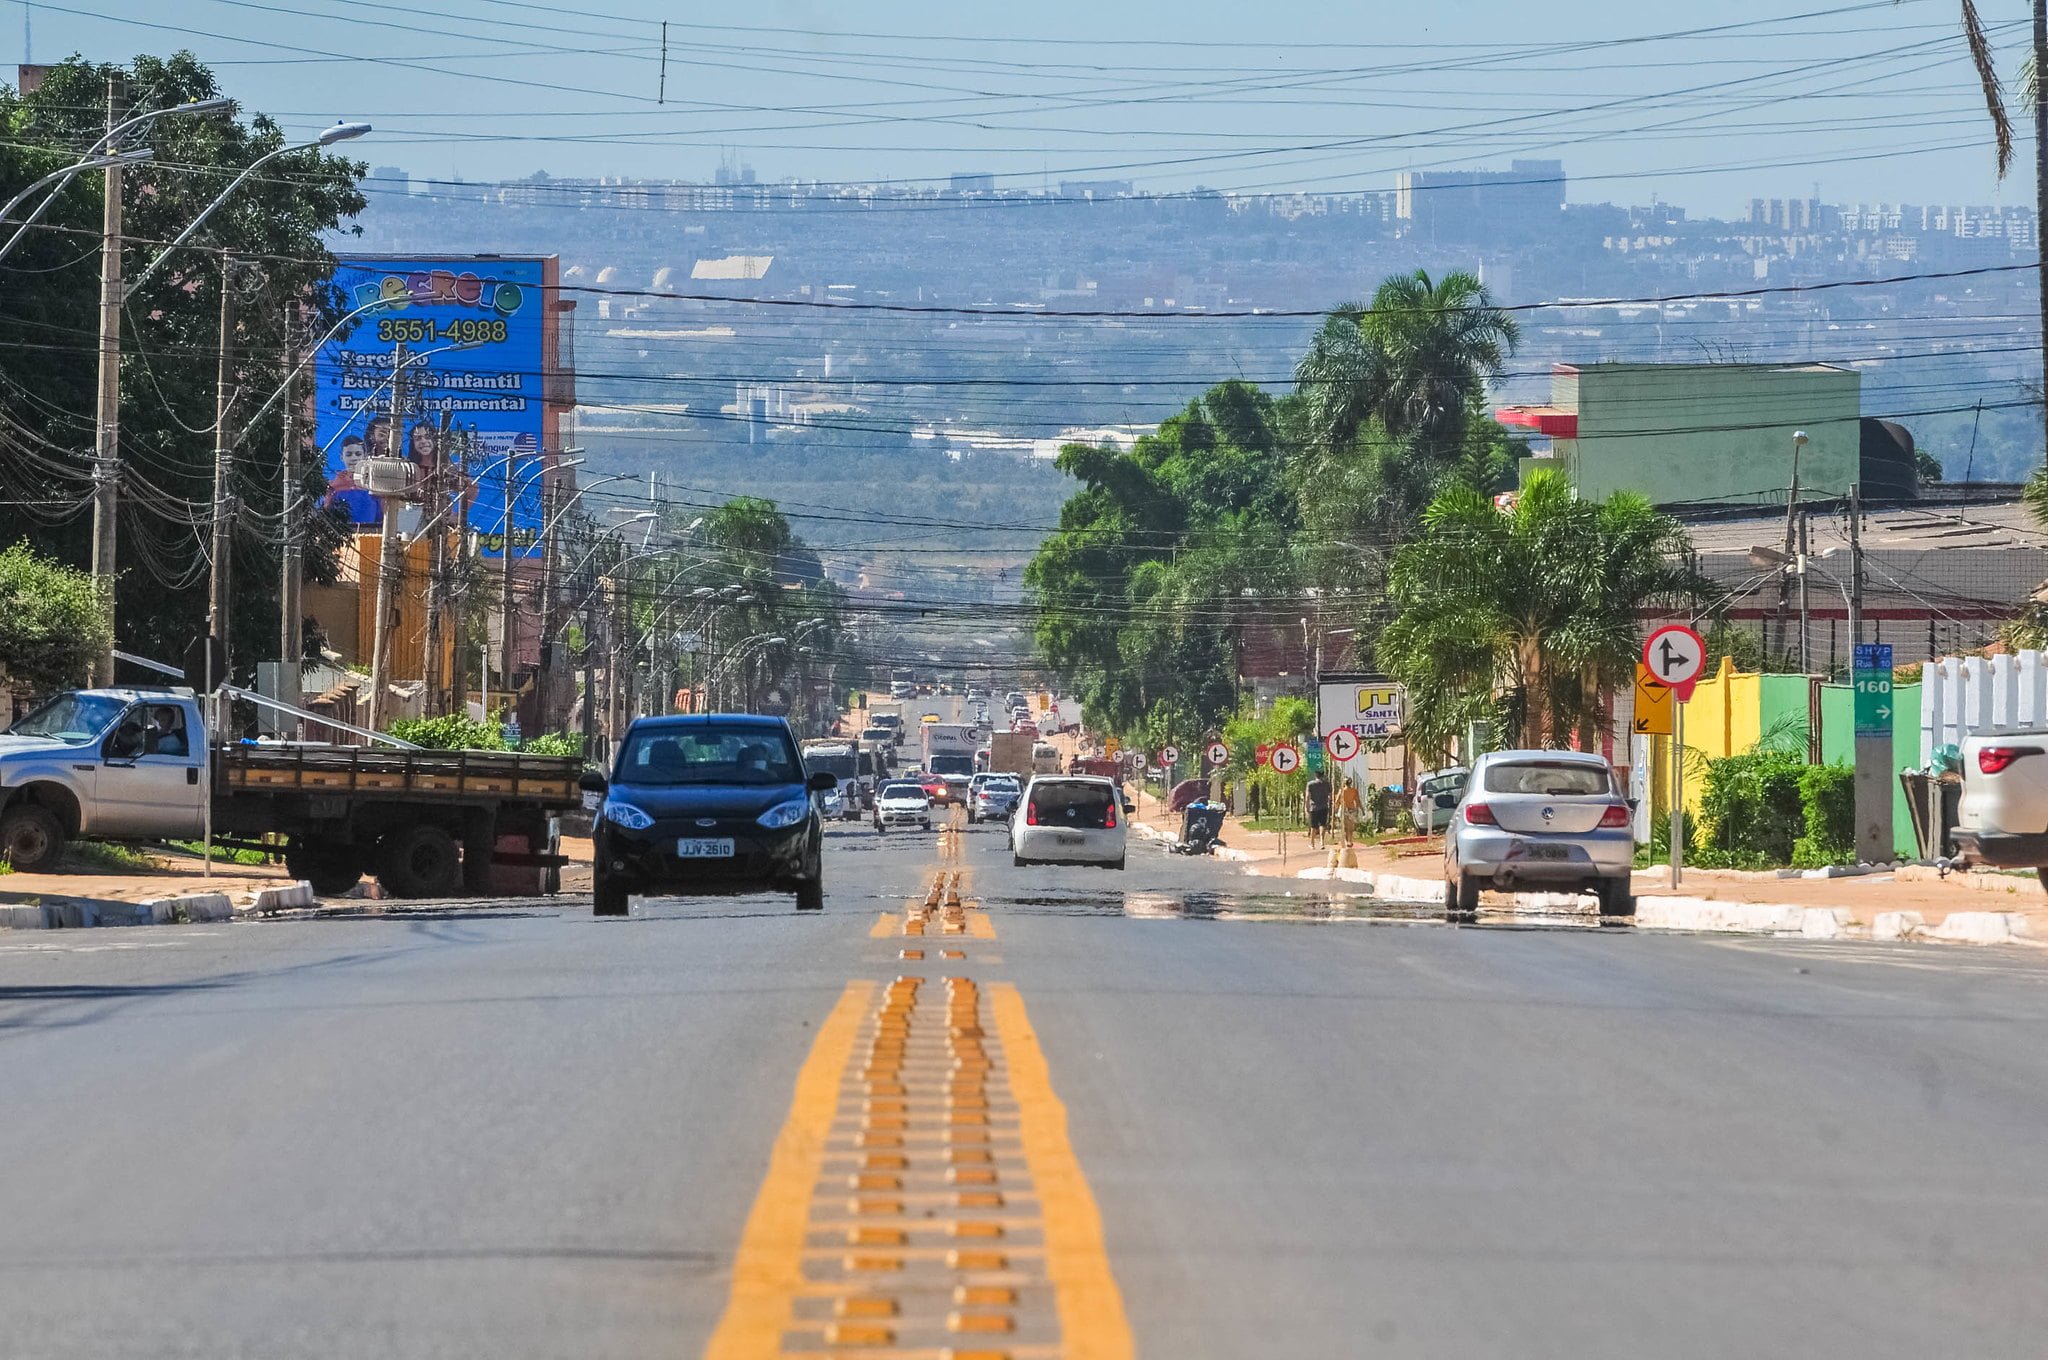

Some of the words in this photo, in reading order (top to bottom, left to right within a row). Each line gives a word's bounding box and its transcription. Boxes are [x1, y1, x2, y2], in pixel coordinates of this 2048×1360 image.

[378, 319, 507, 342] 3551-4988
[340, 351, 430, 367] Berçáio
[444, 374, 521, 388] infantil
[407, 396, 527, 410] undamental
[1856, 680, 1891, 693] 160
